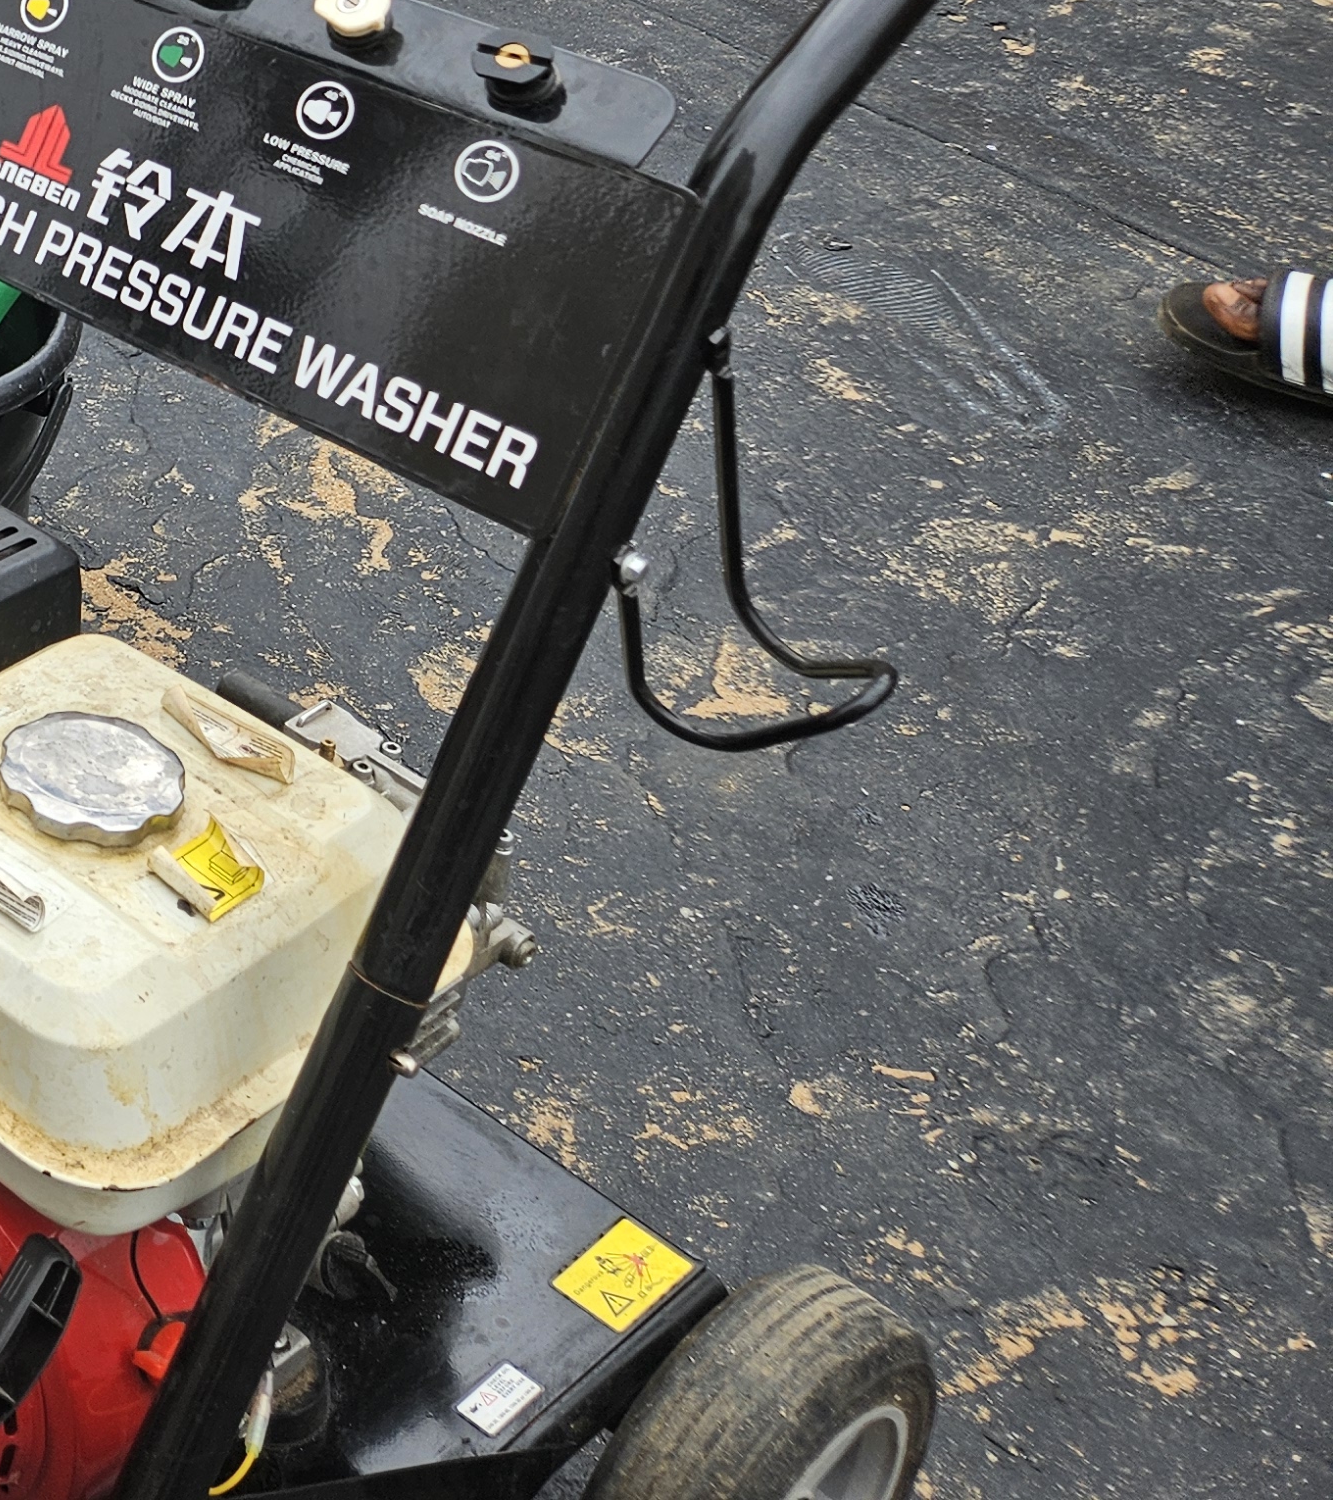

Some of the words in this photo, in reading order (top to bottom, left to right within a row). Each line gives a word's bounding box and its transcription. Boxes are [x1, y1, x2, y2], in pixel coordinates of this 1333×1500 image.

[0, 37, 22, 49] HEAVY
[21, 45, 54, 63] CLEANING
[37, 39, 69, 58] SPRAY
[123, 84, 159, 105] MODERATE
[159, 99, 195, 119] CLEANING
[133, 76, 160, 94] WIDE
[160, 87, 196, 108] SPRAY
[263, 133, 290, 150] LOW
[290, 143, 350, 175] PRESSURE
[282, 154, 320, 175] CHEMICAL
[273, 160, 324, 185] APPLICATION
[418, 204, 454, 224] SOAP
[453, 217, 507, 246] NOZZLE
[34, 219, 293, 376] PRESSURE
[294, 335, 539, 492] WASHER
[573, 1270, 605, 1297] Dangerous
